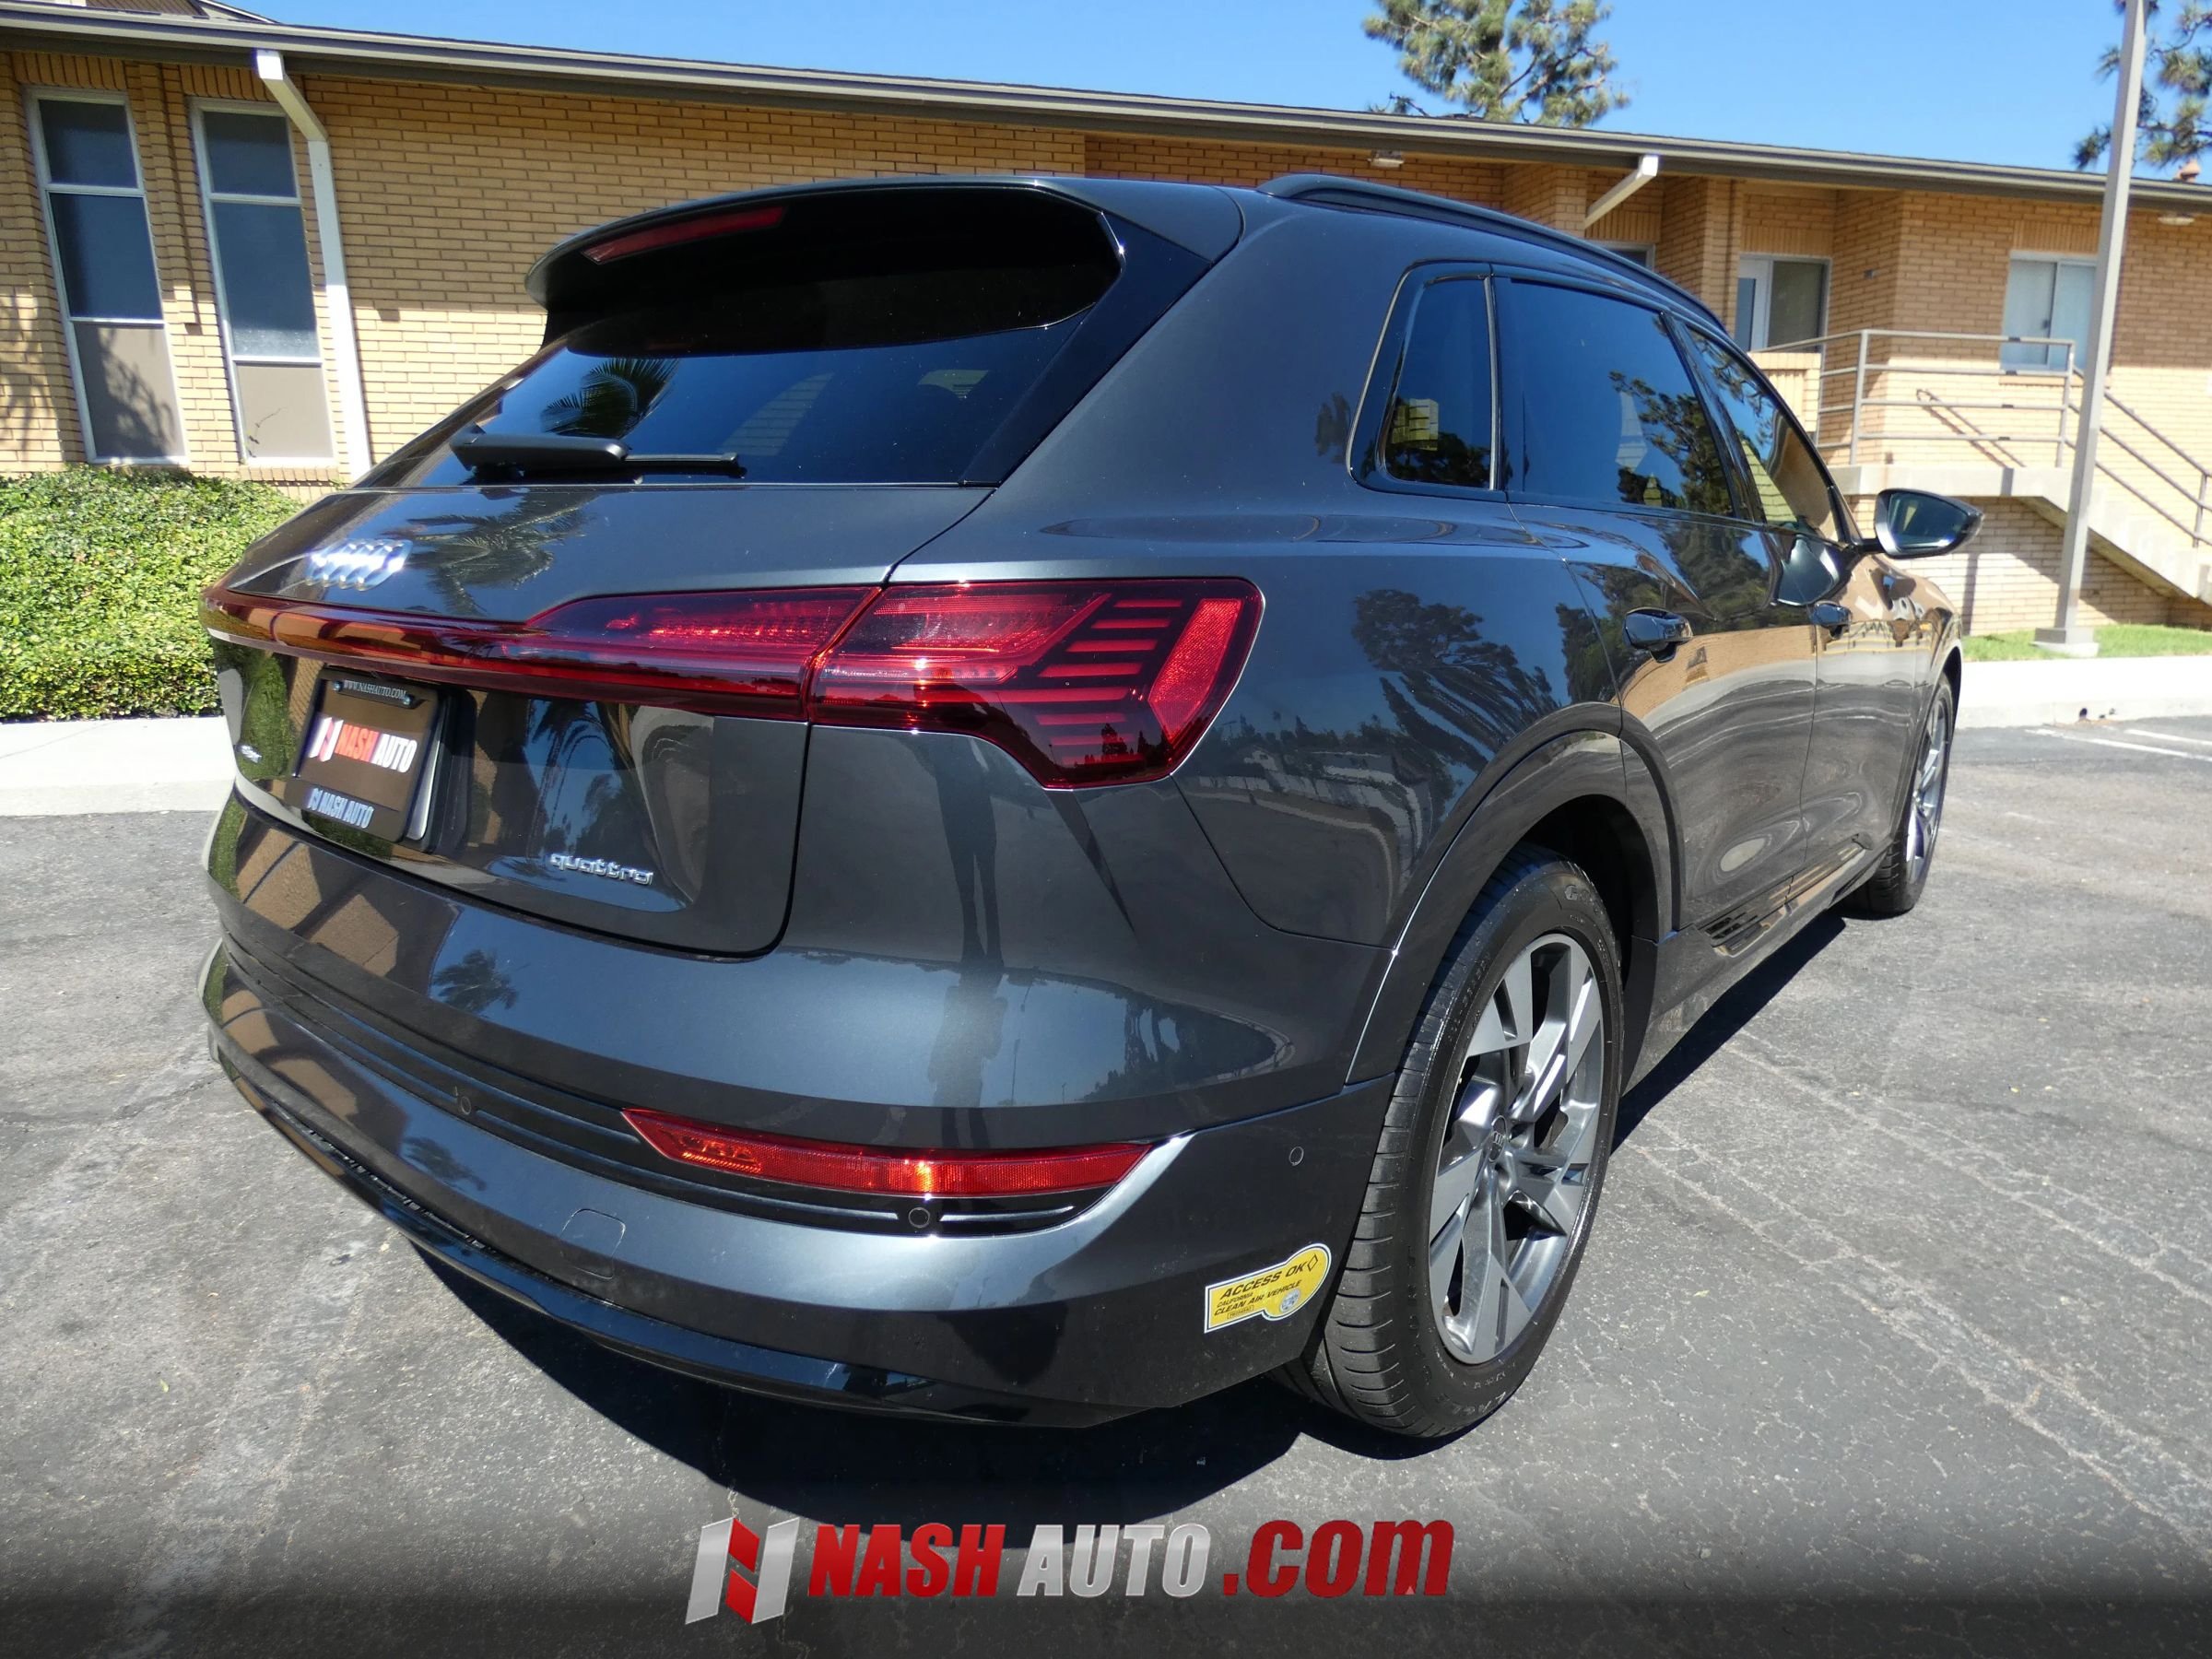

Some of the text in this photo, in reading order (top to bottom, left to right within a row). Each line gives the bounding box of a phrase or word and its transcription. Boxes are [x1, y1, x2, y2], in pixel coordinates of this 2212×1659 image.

[344, 679, 407, 700] WWW.NASHAUTO.COM
[335, 724, 380, 762] NASH
[371, 733, 418, 773] AUTO
[317, 792, 348, 819] NASH
[342, 800, 375, 829] AUTO
[550, 853, 654, 885] quattro
[1214, 1300, 1247, 1316] CLEAN
[1247, 1293, 1265, 1306] AIR
[1266, 1279, 1302, 1299] VEHICLE
[1220, 1261, 1309, 1300] ACCESS OK
